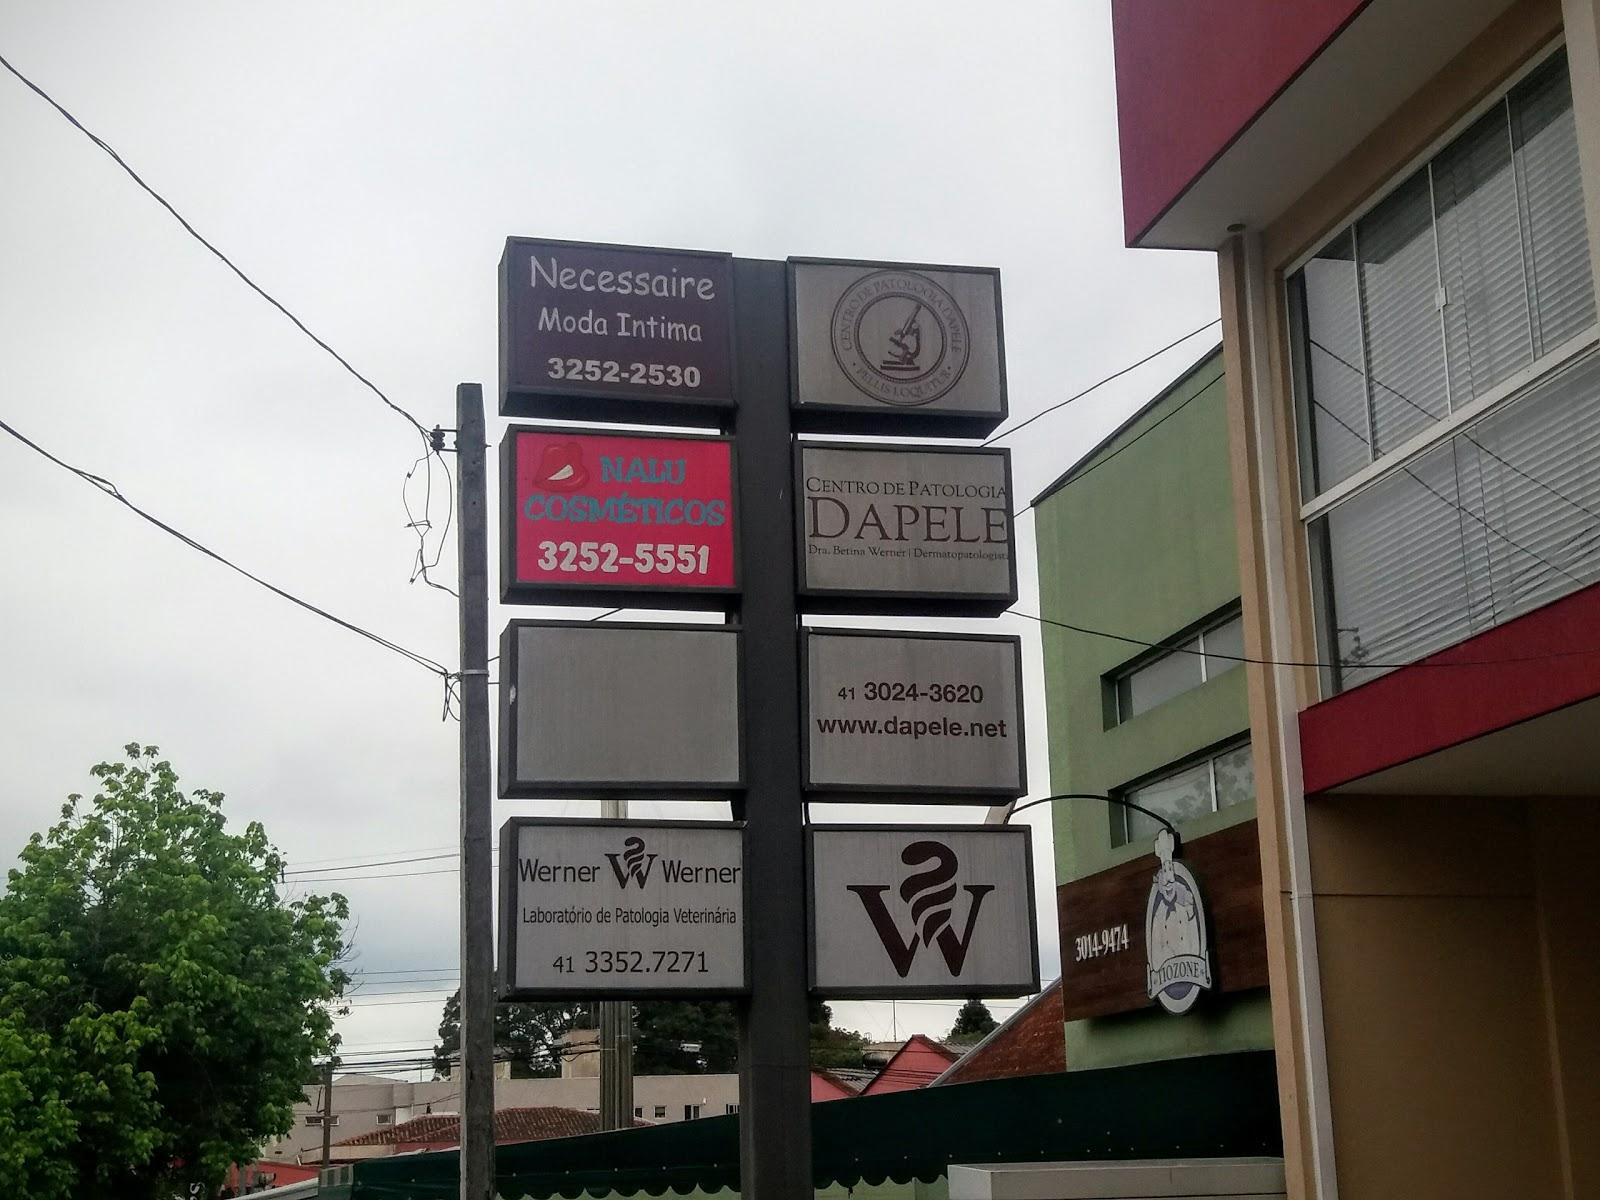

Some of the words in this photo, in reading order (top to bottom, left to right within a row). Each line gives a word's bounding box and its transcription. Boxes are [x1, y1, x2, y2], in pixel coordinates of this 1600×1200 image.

[530, 255, 715, 300] Necessaire
[538, 306, 608, 335] Moda
[616, 312, 702, 342] Intima
[548, 357, 701, 388] 3252-2530
[599, 455, 687, 485] NALU
[806, 477, 880, 495] CENTRO
[884, 482, 905, 496] DE
[909, 480, 1006, 499] PATOLOGIA
[523, 491, 726, 526] COSMÉTICOS
[806, 496, 1008, 544] DAPELE
[537, 541, 710, 575] 3252-5551
[808, 544, 831, 555] Dra.
[833, 545, 865, 556] Betina
[868, 546, 906, 558] Werner
[838, 687, 855, 700] 41
[864, 682, 984, 704] 3024-3620
[817, 716, 1008, 740] www.dapele.net
[518, 858, 600, 883] Werner
[662, 860, 741, 884] Werner
[523, 906, 592, 924] Laboratório
[596, 907, 611, 924] de
[615, 907, 669, 927] Patologia
[673, 906, 737, 925] Veterinária
[1075, 923, 1129, 962] 3014-9474
[553, 956, 575, 973] 41
[585, 951, 709, 974] 3352.7271
